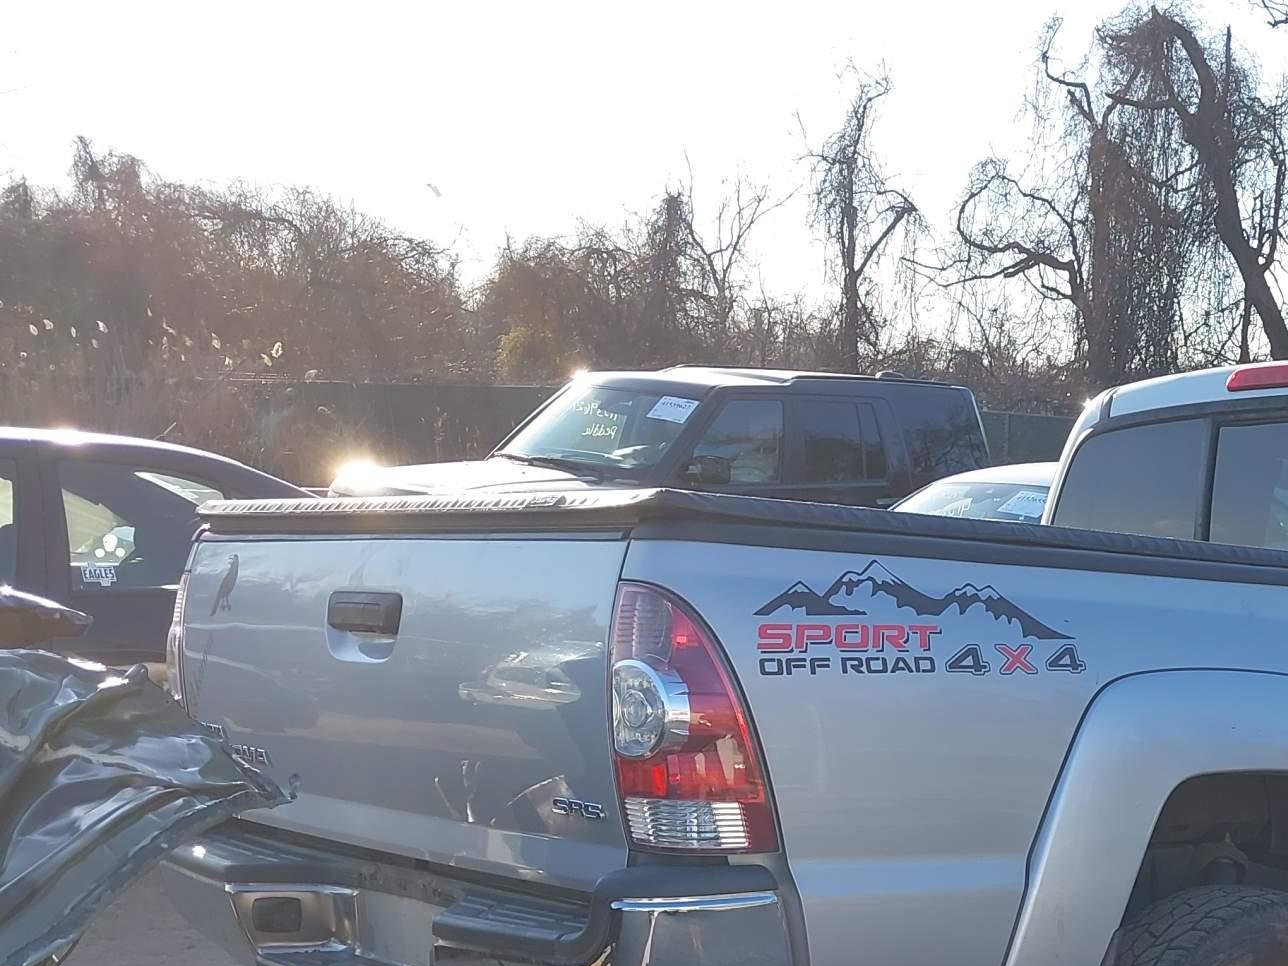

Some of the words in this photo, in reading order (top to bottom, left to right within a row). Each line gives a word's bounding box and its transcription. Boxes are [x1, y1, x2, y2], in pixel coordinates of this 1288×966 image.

[83, 568, 115, 579] EAGLES
[757, 623, 942, 653] SPORT
[759, 658, 831, 675] OFF
[841, 657, 936, 674] ROAD
